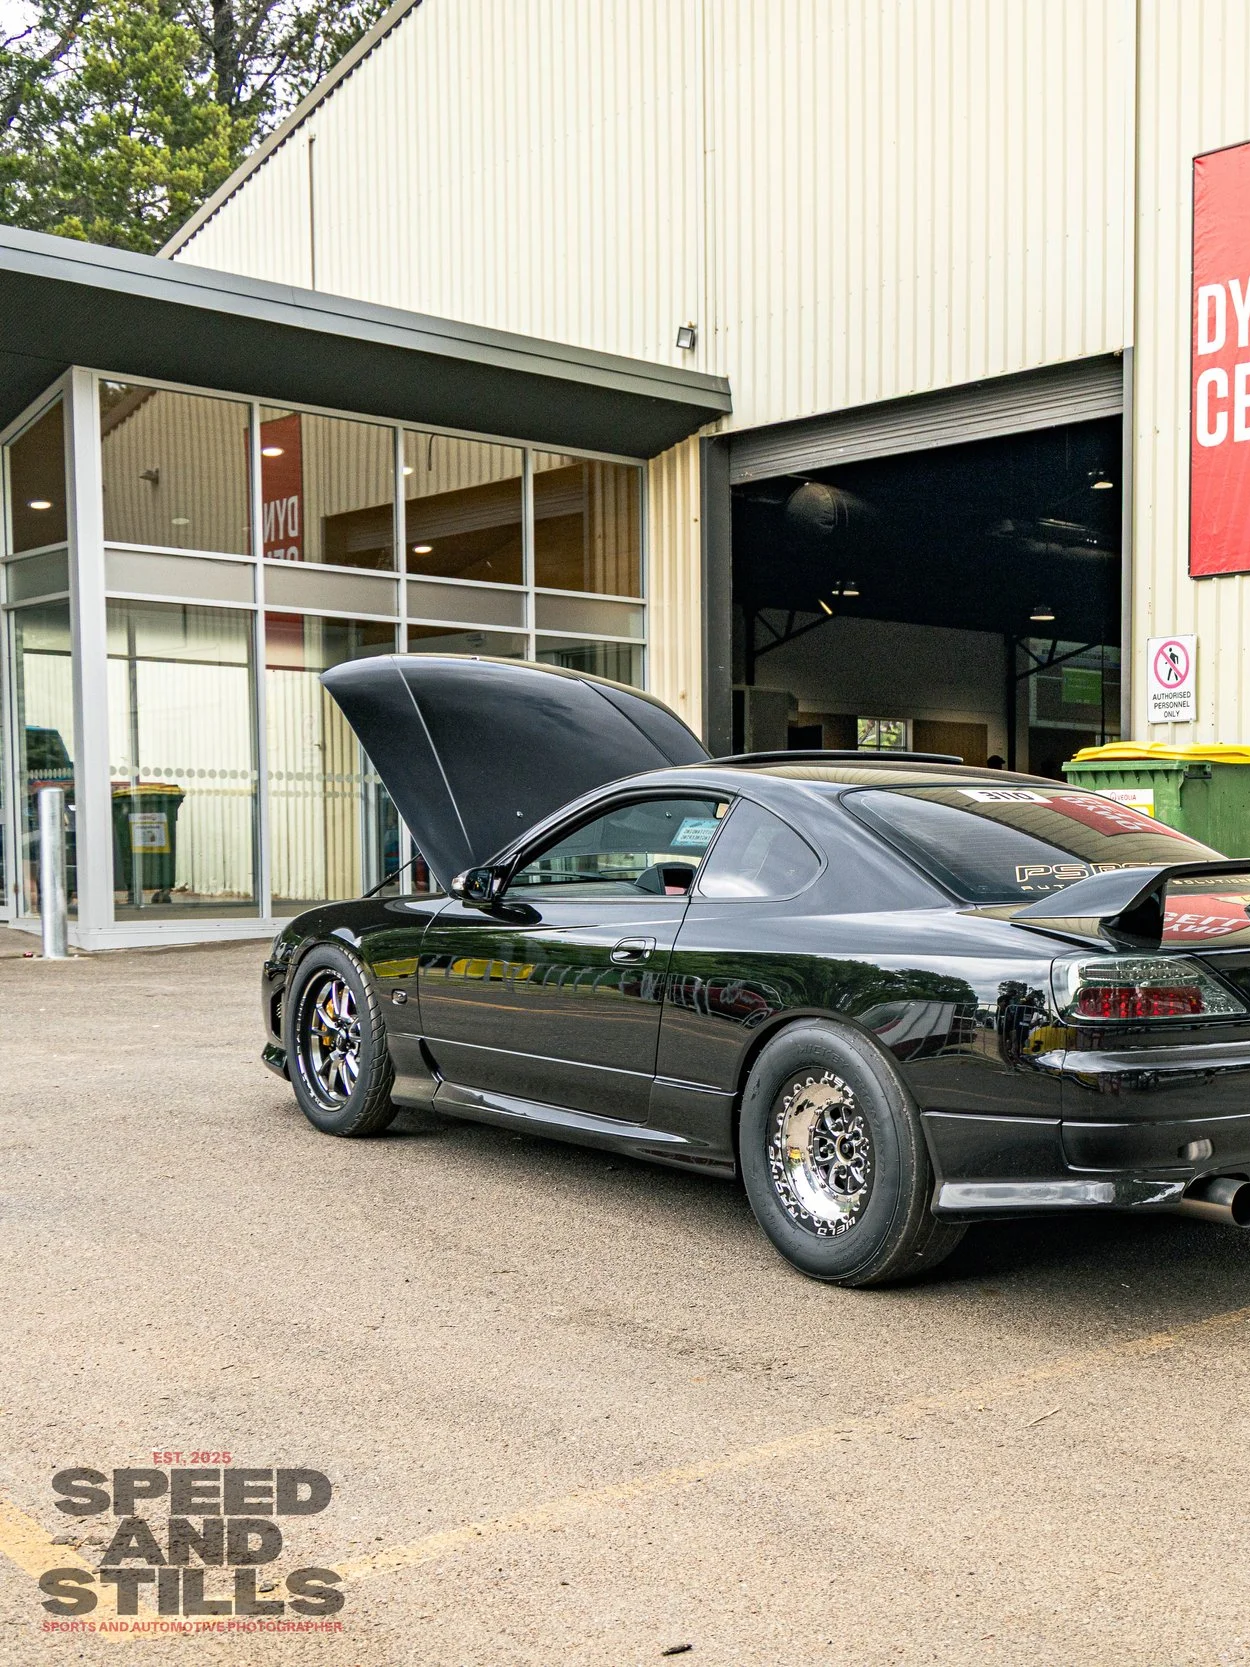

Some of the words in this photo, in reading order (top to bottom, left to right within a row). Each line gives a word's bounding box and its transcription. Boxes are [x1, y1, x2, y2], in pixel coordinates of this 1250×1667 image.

[1152, 691, 1191, 701] AUTHORISED
[1153, 700, 1190, 710] PERSONNEL
[1163, 710, 1180, 718] ONLY
[824, 1071, 855, 1098] USA
[817, 1216, 857, 1236] WELD
